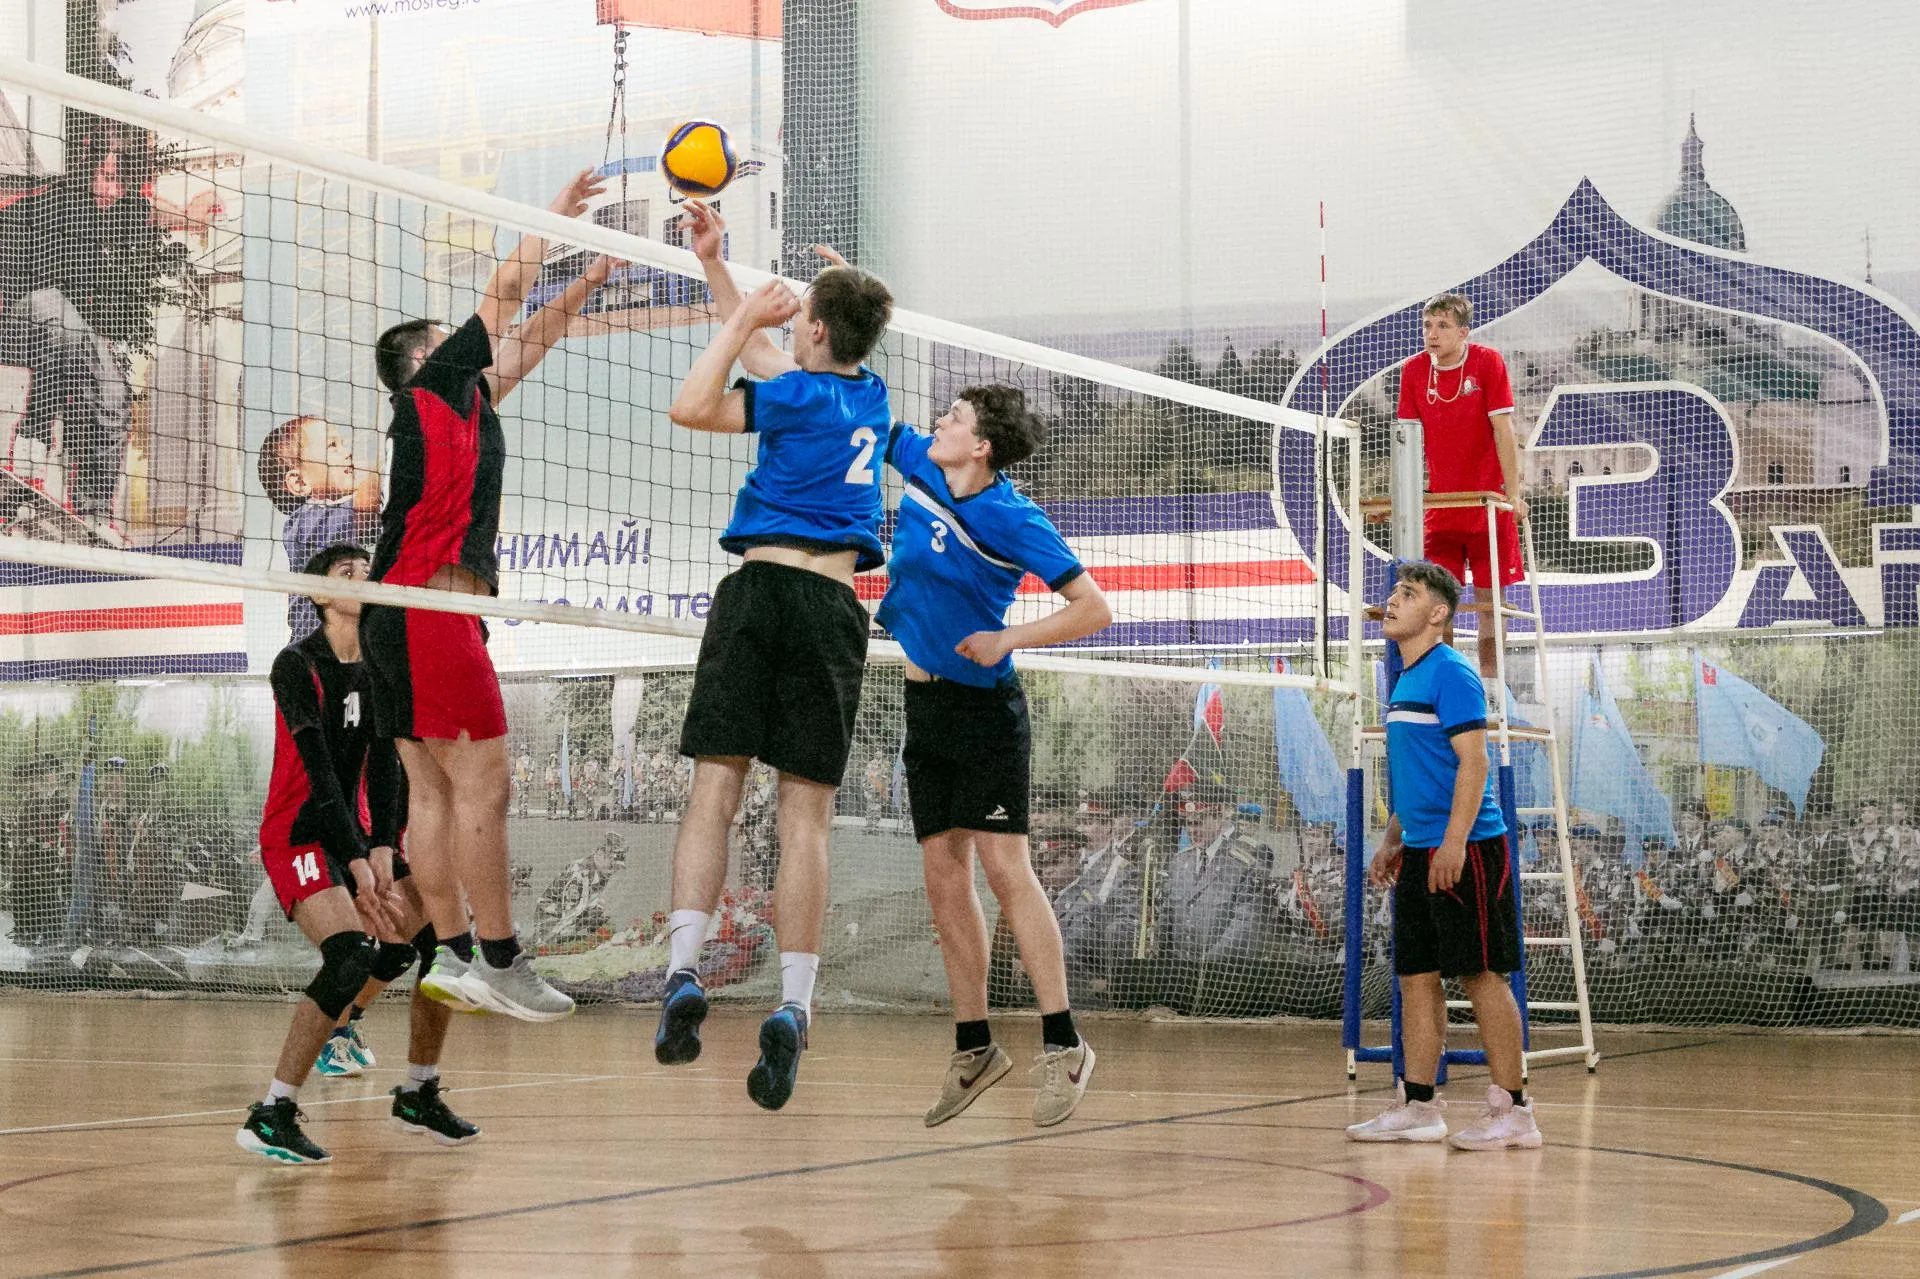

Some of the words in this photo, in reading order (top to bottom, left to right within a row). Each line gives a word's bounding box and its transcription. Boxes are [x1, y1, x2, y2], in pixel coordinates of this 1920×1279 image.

[344, 0, 481, 18] www.mosreg.
[845, 427, 877, 484] 2
[931, 521, 947, 552] 3
[292, 852, 321, 886] 14
